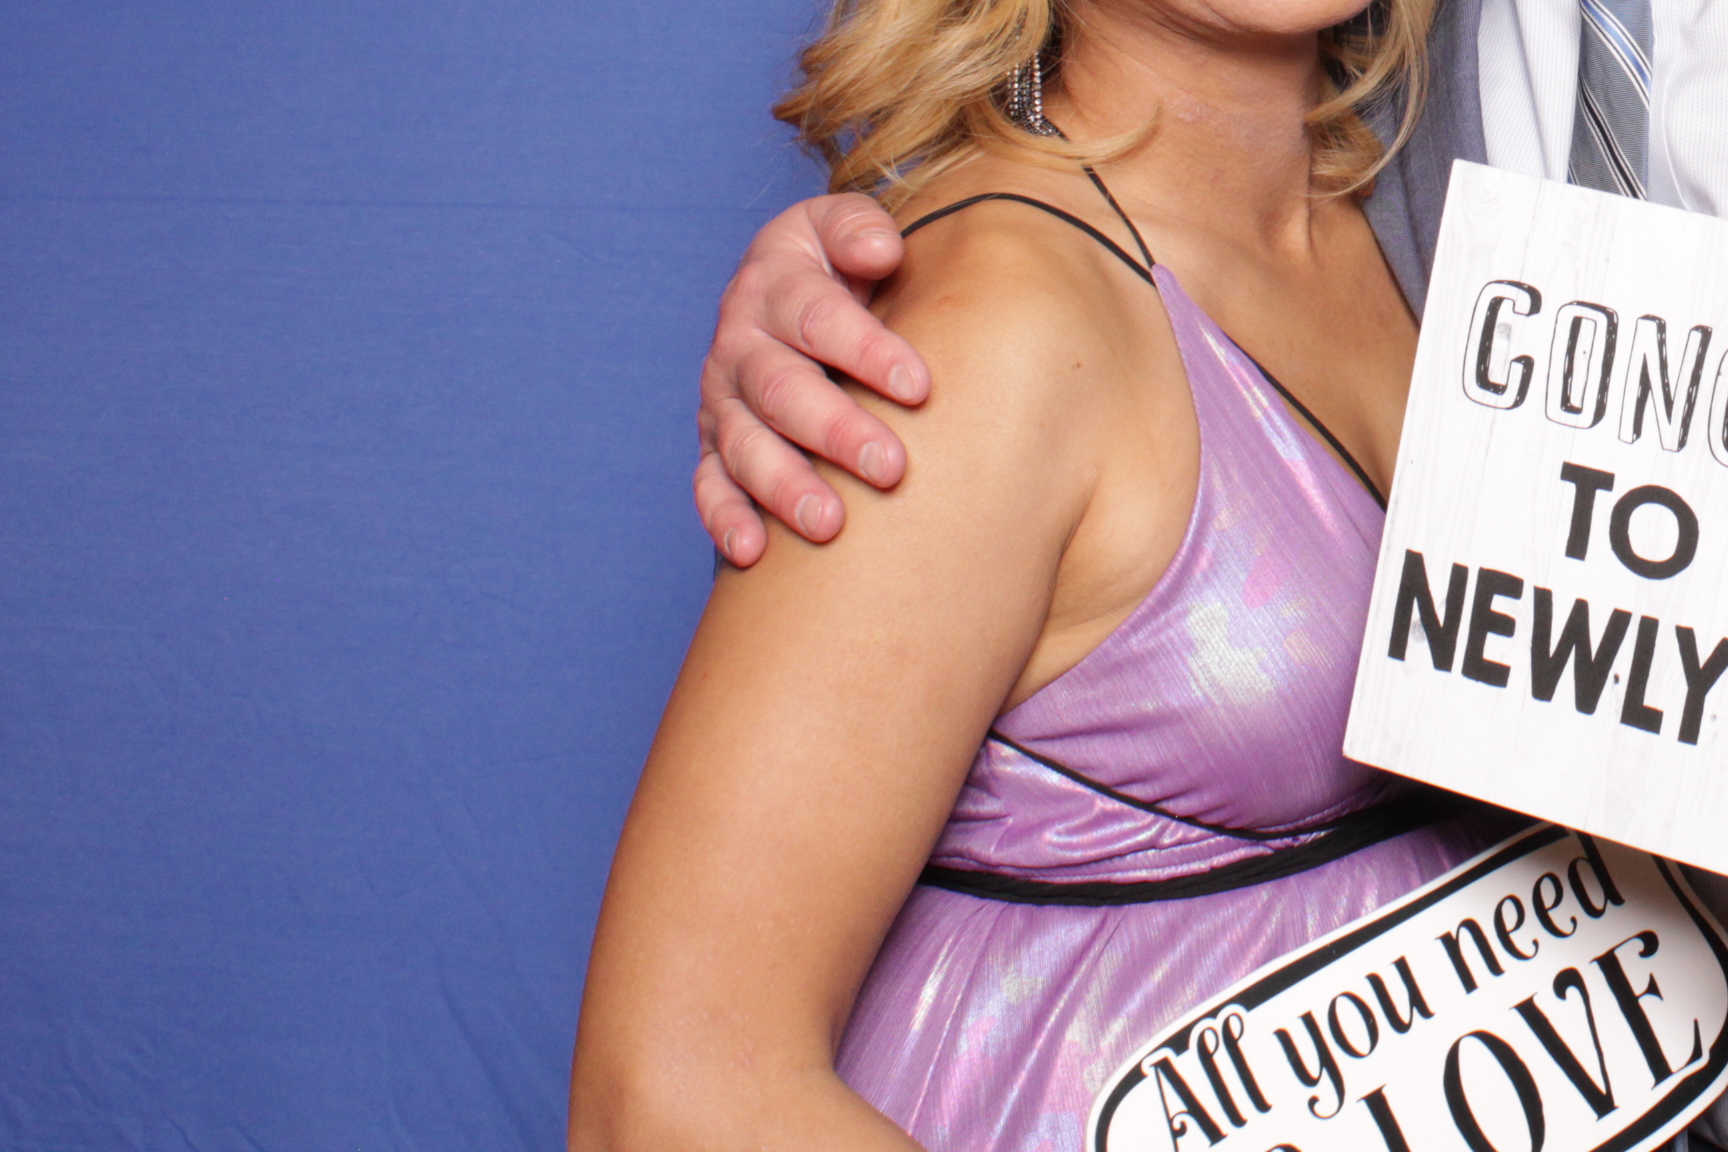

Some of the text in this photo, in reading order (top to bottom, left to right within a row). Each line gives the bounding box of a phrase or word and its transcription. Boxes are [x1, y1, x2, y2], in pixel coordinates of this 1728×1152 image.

[1560, 462, 1699, 580] TO
[1150, 830, 1625, 1152] All you need
